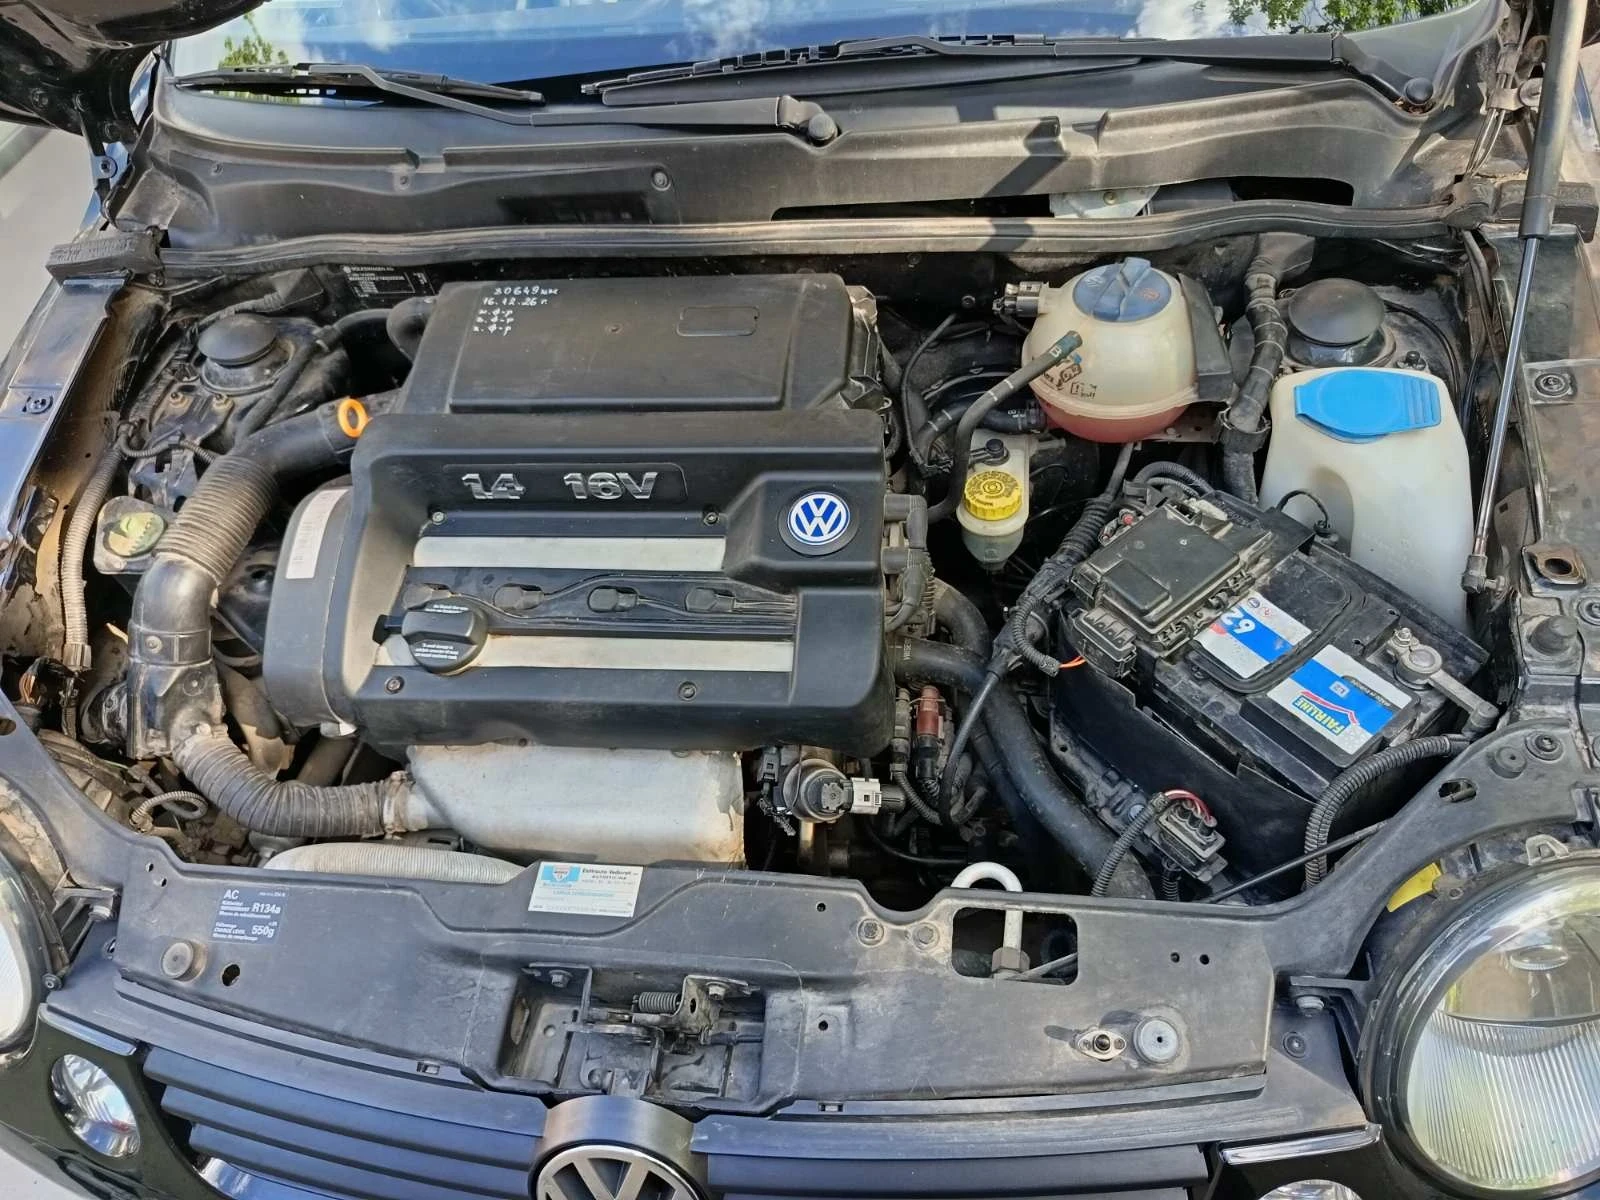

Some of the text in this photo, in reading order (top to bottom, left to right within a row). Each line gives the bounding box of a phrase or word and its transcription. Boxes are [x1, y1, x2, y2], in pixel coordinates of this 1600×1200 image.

[563, 471, 658, 500] 16V
[788, 491, 851, 545] VW
[1295, 698, 1346, 735] FAIRLINE
[223, 889, 240, 900] AC
[251, 902, 281, 914] R134a
[251, 925, 275, 938] 550g
